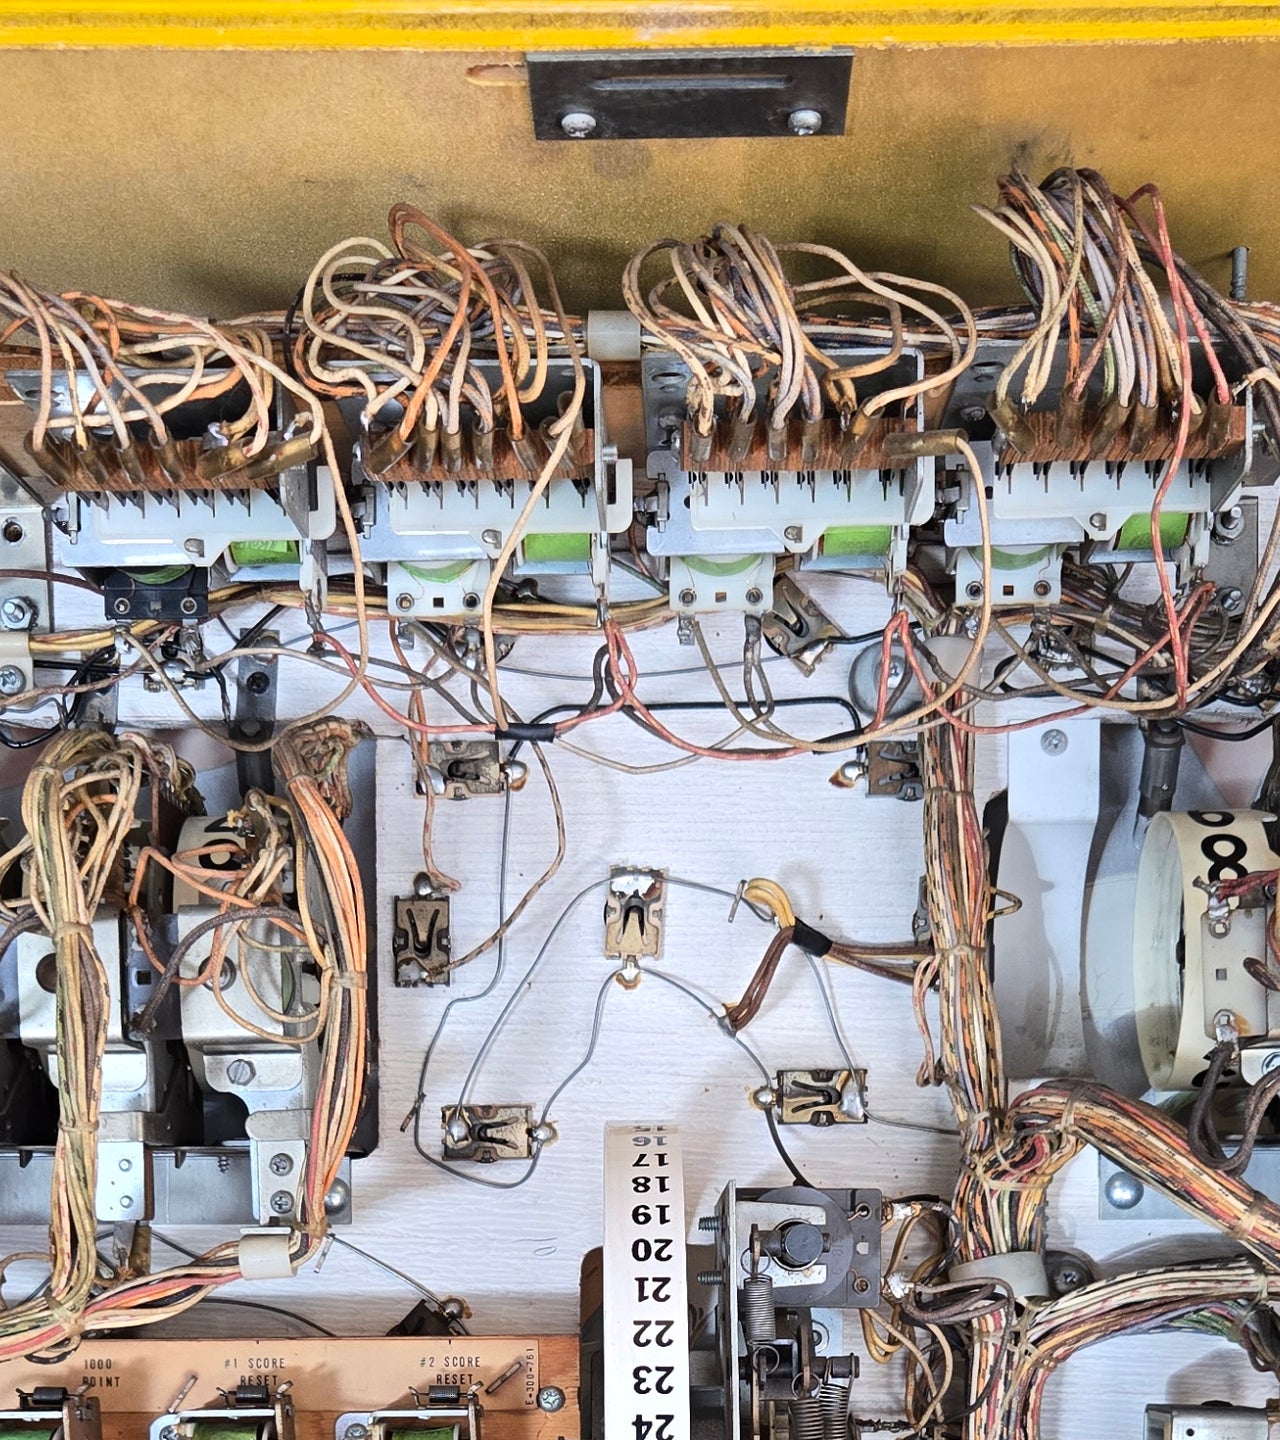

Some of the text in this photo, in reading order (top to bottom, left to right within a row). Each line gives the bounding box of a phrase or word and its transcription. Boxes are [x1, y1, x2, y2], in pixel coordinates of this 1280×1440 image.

[632, 1153, 669, 1167] 17
[632, 1176, 670, 1193] 18
[632, 1204, 671, 1225] 19
[632, 1238, 673, 1262] 20
[634, 1277, 671, 1302] 21
[633, 1320, 675, 1347] 22
[84, 1359, 112, 1370] 1000
[224, 1358, 286, 1369] #1 SCORE
[420, 1356, 480, 1368] #2 SCORE
[82, 1376, 121, 1387] POINT
[240, 1375, 278, 1386] RESET
[436, 1374, 473, 1385] RESET
[525, 1348, 535, 1406] E-300-761
[632, 1365, 675, 1395] 23
